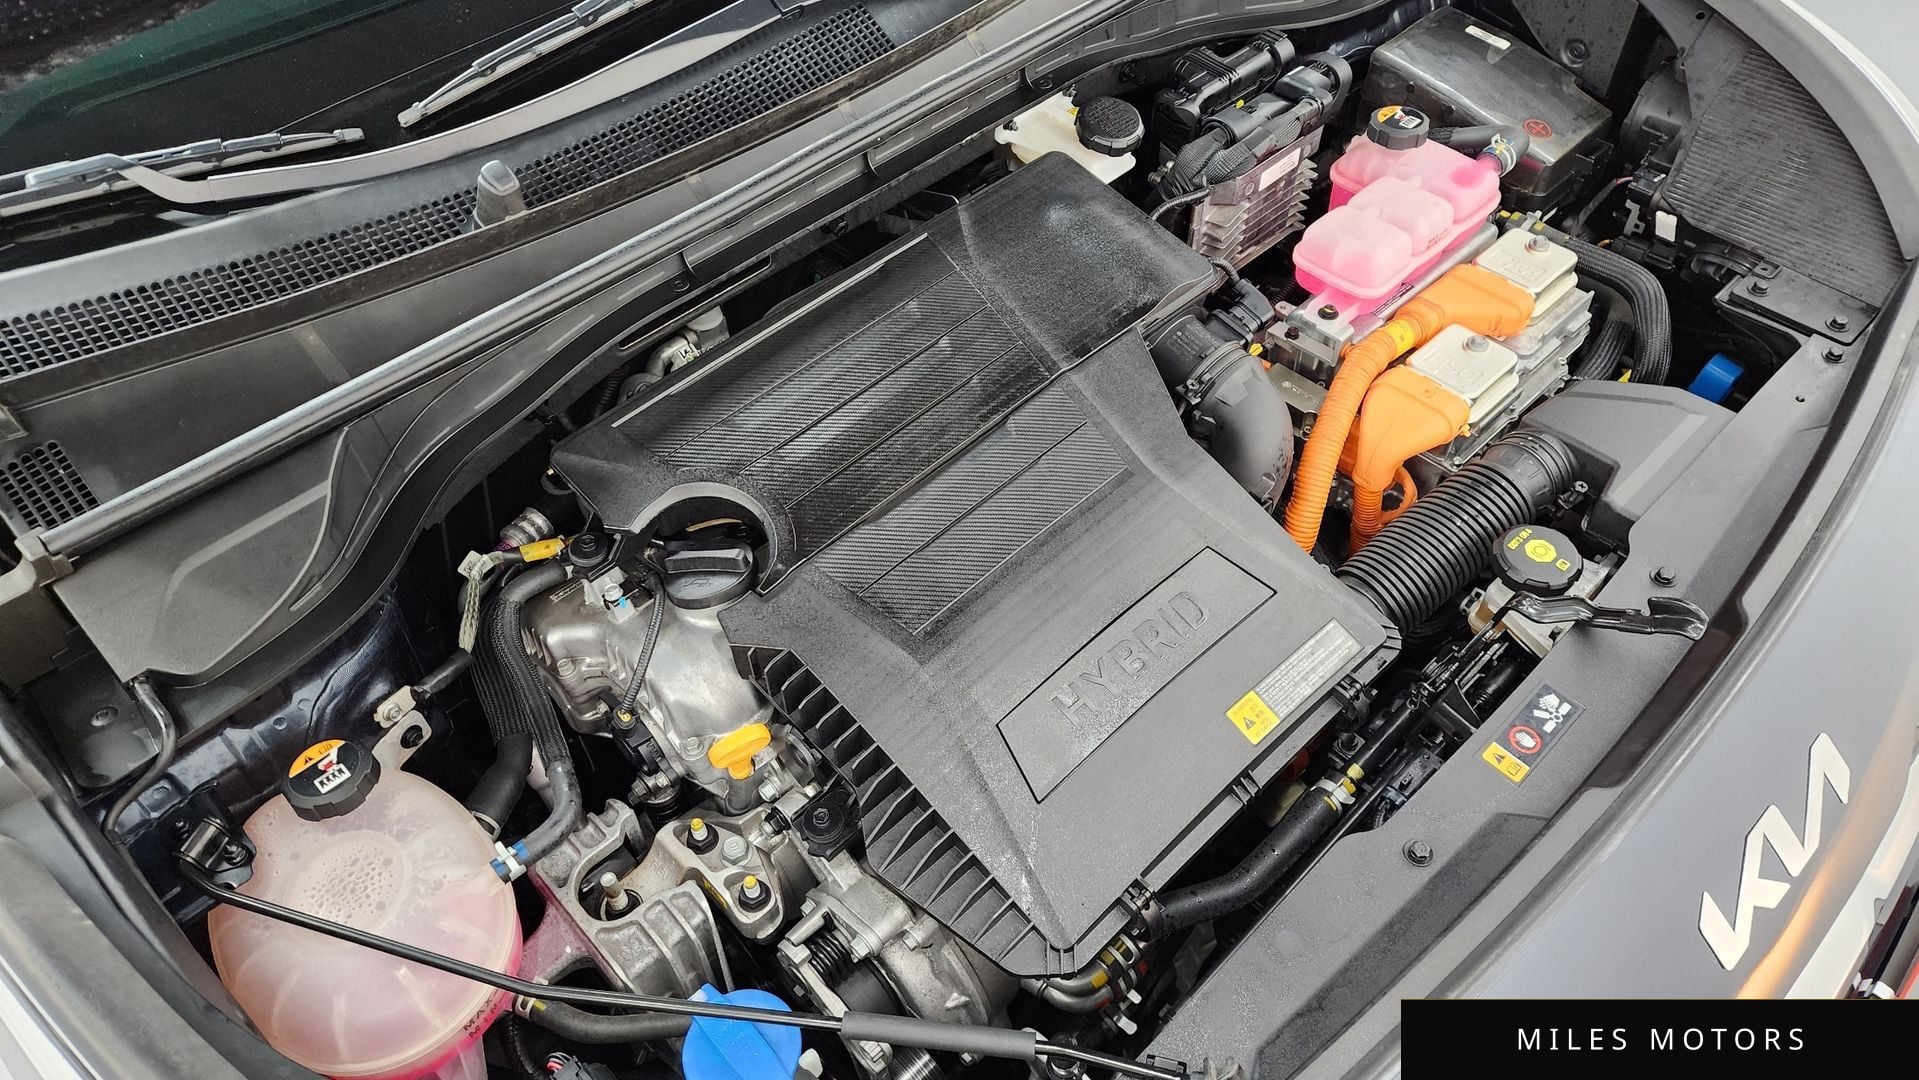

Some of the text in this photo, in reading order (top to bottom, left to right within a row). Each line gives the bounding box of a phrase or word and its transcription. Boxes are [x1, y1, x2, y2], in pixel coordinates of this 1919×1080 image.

[1050, 591, 1209, 731] HYBRID
[1698, 731, 1850, 971] KIA
[463, 998, 493, 1031] MAX
